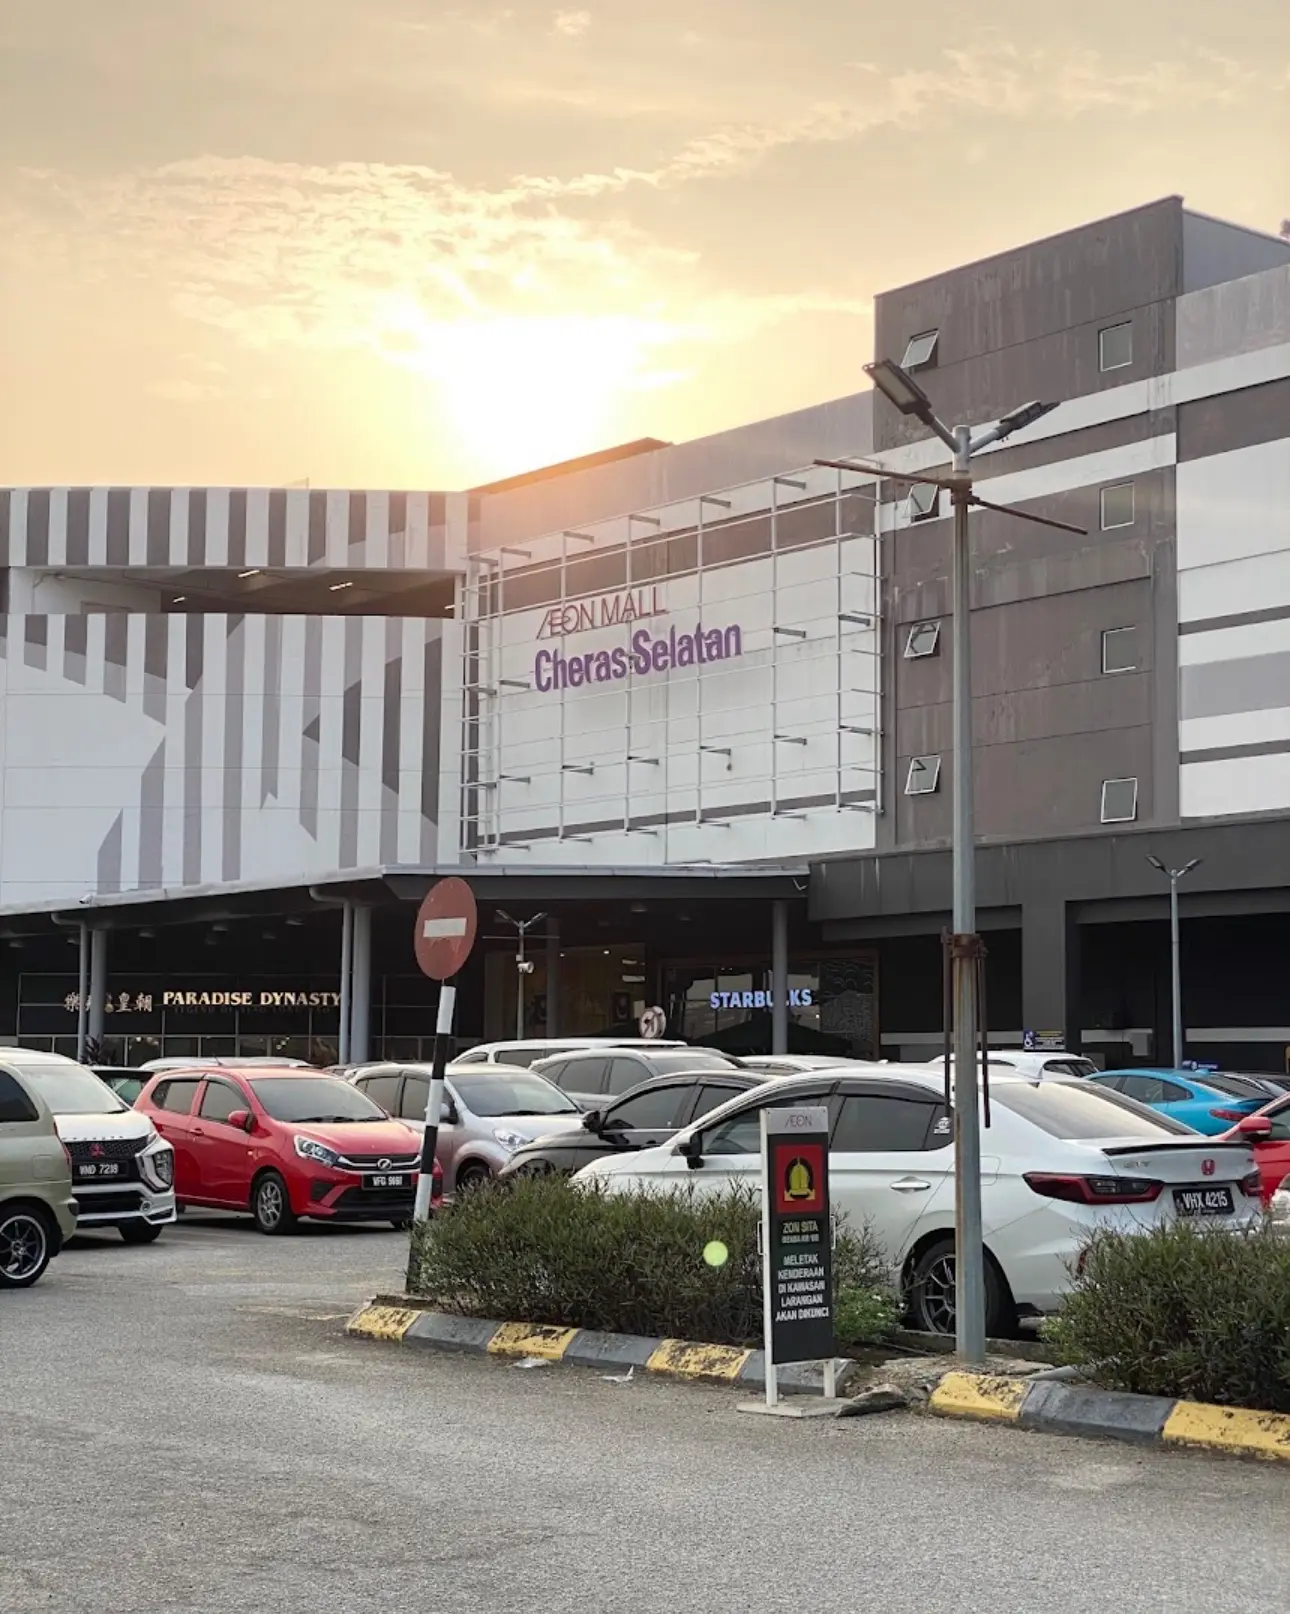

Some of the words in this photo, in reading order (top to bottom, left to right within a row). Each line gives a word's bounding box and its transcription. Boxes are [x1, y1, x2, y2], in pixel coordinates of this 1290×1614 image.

[601, 587, 669, 626] MALL
[535, 647, 627, 692] Cheras
[632, 622, 742, 675] Selatan
[163, 991, 253, 1006] PARADISE
[260, 991, 340, 1006] DYNASTY
[710, 989, 812, 1009] STARBUKS
[1182, 1193, 1204, 1209] VHX
[1205, 1191, 1228, 1208] 4215
[783, 1221, 800, 1234] ZON
[801, 1220, 819, 1232] SITA
[783, 1254, 819, 1266] MELETAK
[778, 1266, 824, 1280] KENDERAAN
[778, 1283, 787, 1294] DI
[787, 1280, 826, 1293] KAWASAN
[781, 1294, 823, 1308] LARANGAN
[775, 1310, 797, 1322] AKAN
[798, 1307, 829, 1320] DIKUNCI
